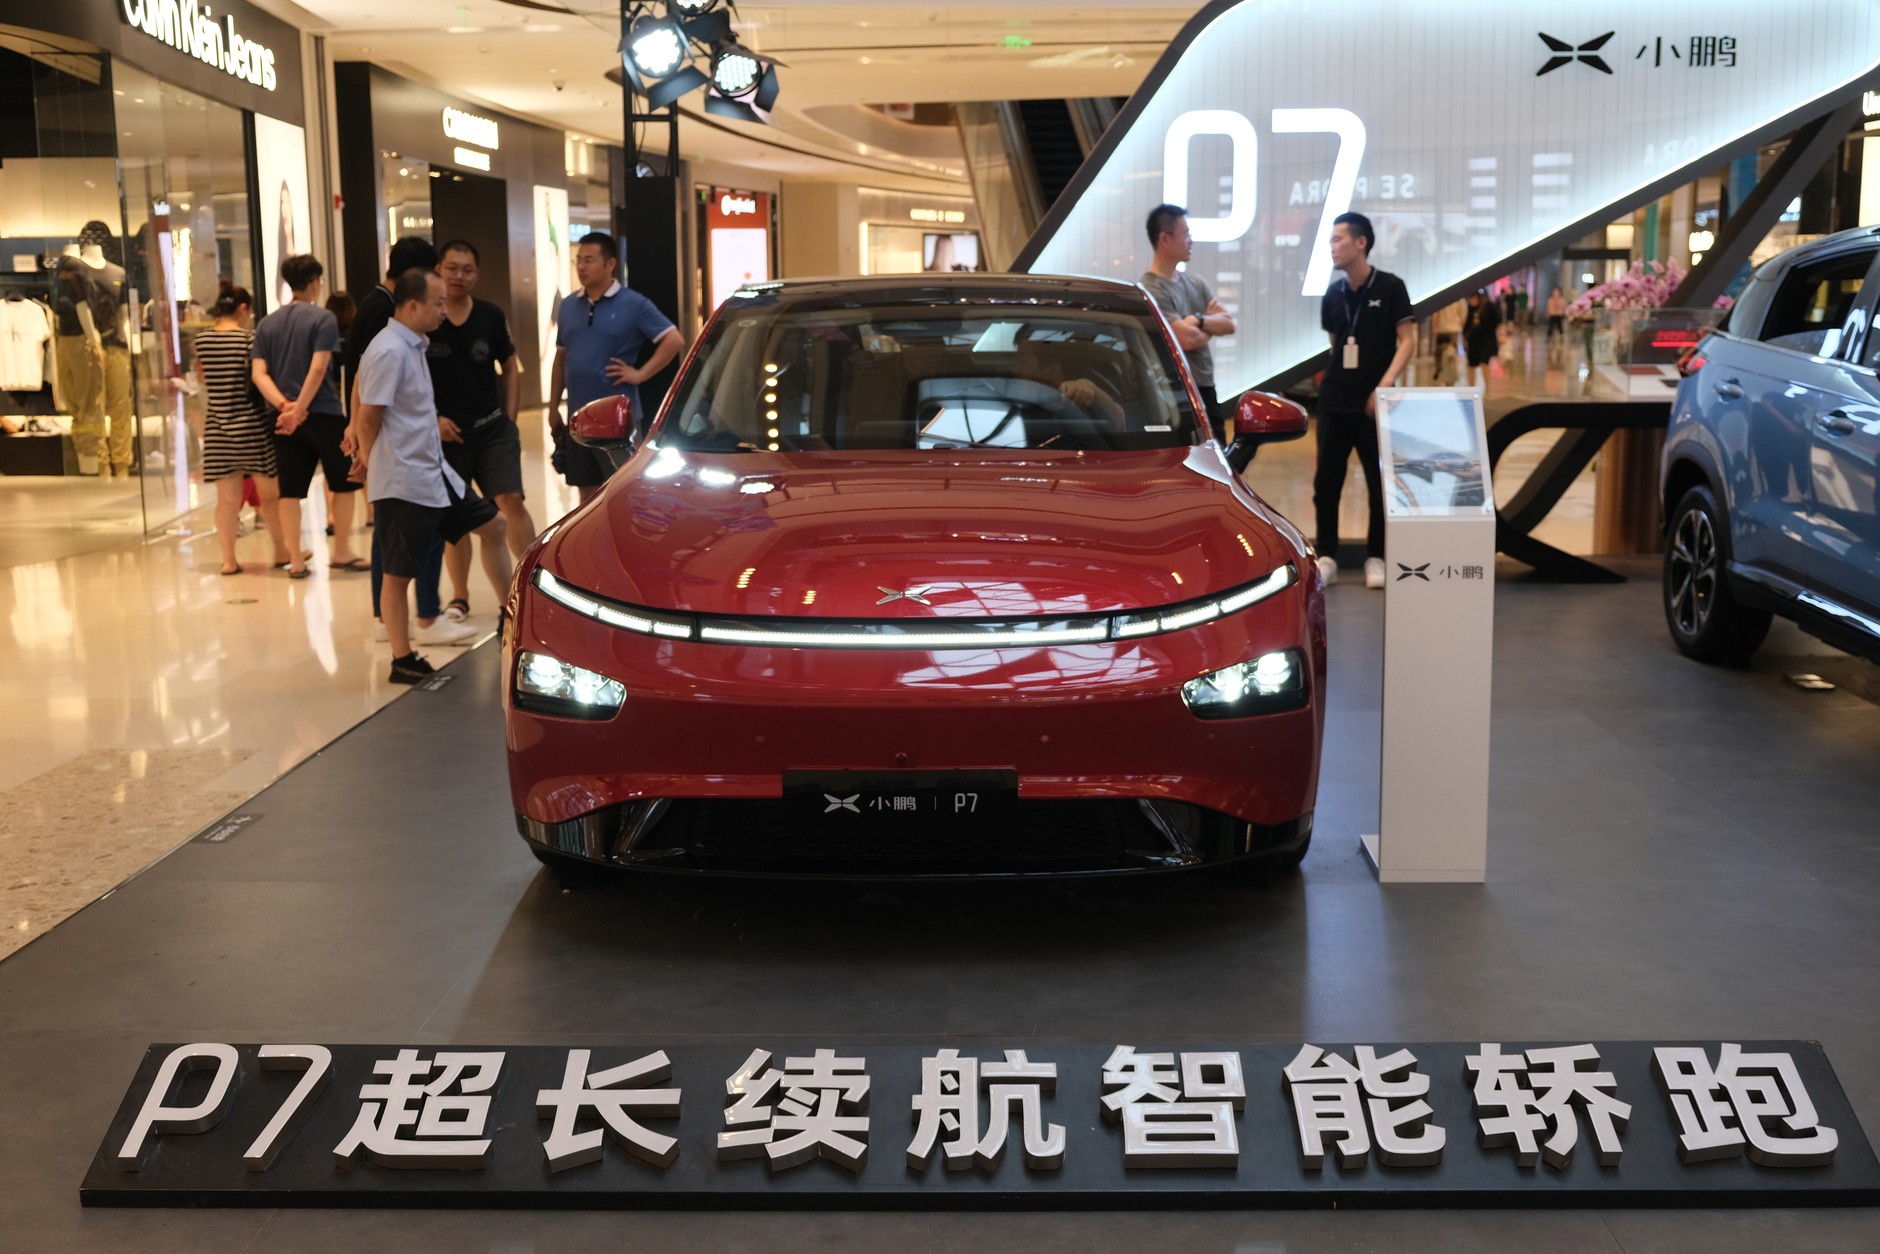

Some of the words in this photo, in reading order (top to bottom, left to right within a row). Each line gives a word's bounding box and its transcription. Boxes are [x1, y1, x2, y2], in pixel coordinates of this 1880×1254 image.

[224, 14, 276, 92] Jeans
[1635, 36, 1737, 68] 小鹏
[1439, 565, 1483, 579] 小鹏
[869, 796, 917, 811] 小鹏
[954, 792, 978, 813] P7
